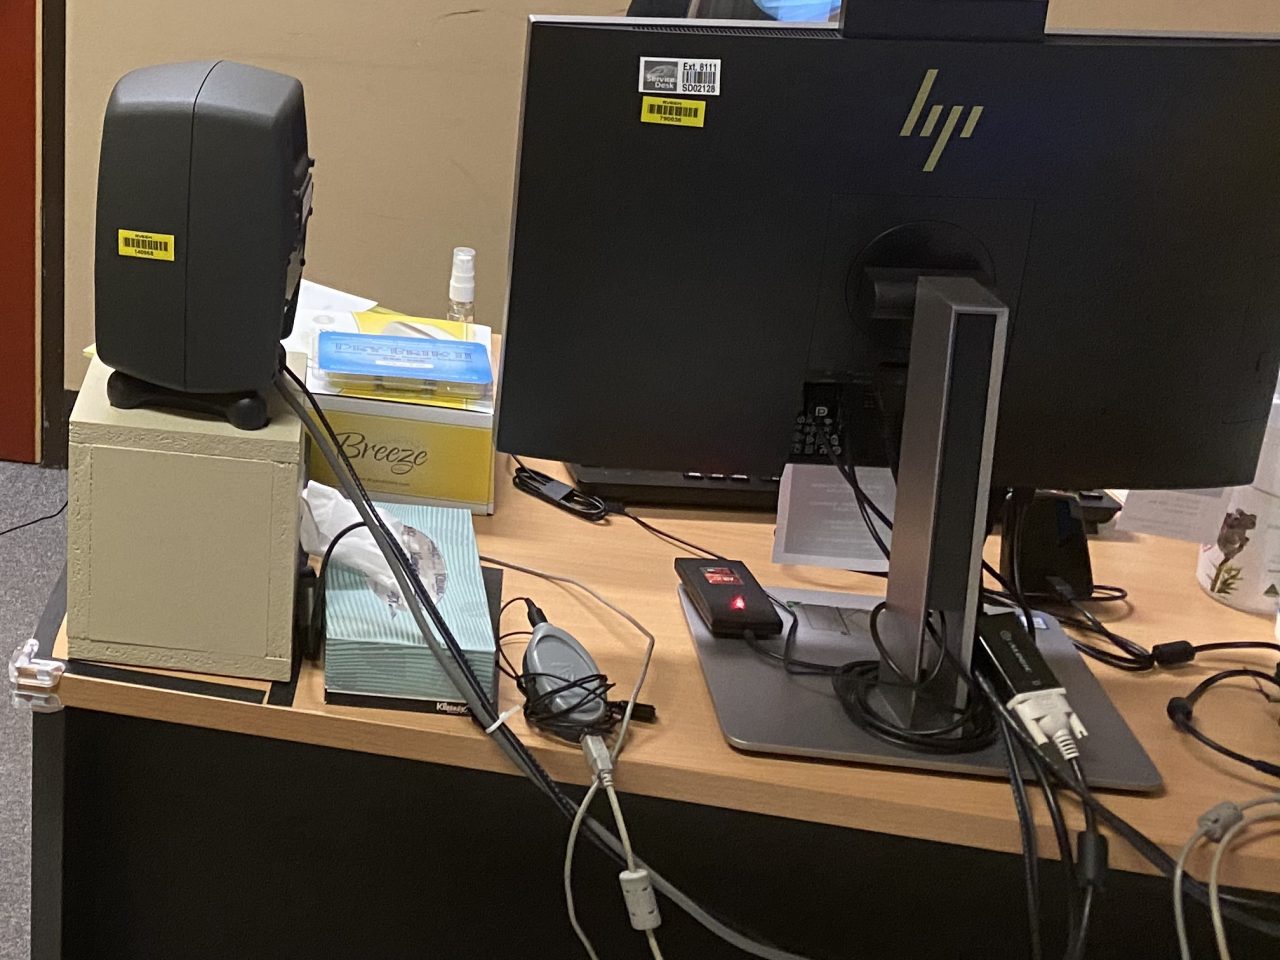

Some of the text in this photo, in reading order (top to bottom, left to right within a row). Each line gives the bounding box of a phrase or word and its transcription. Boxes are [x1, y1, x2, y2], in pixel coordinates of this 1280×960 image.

[699, 63, 717, 72] 8111
[646, 73, 676, 83] Service
[682, 84, 716, 93] SD02128
[899, 69, 984, 172] hp
[336, 431, 428, 475] Breeze
